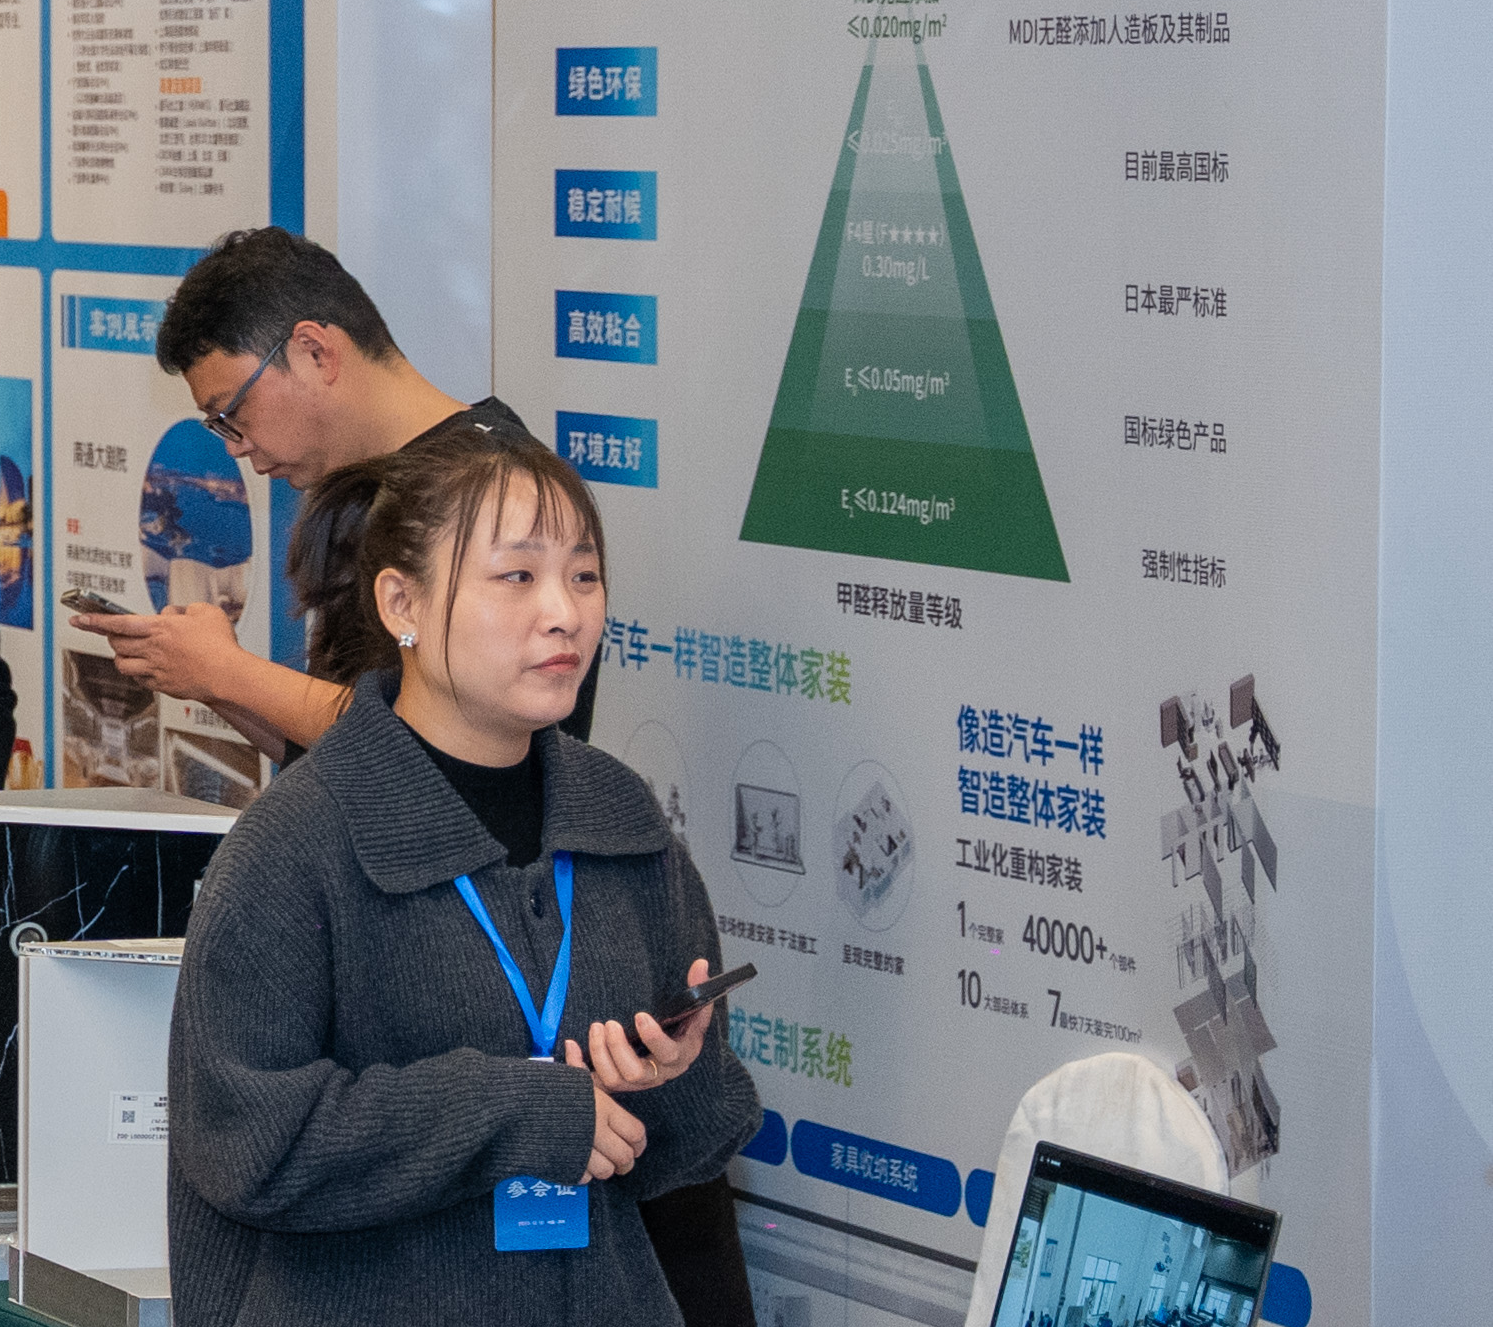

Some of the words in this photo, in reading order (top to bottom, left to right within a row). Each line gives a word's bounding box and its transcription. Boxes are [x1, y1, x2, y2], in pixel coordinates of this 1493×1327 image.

[1009, 11, 1231, 46] MDI无醛添加人造板及其制品
[567, 65, 642, 101] 绿色环保
[1124, 150, 1230, 183] 目前最高国标
[567, 187, 642, 225] 稳定耐候
[861, 254, 931, 285] 0.30mg/L
[1124, 283, 1228, 319] 日本最严标准
[567, 310, 642, 348] 高效粘合
[567, 430, 643, 472] 环境友好
[1123, 414, 1227, 455] 国标绿色产品
[1141, 548, 1227, 589] 强制性指标
[836, 581, 963, 630] 甲醛释放量等级
[957, 704, 1105, 776] 像造汽车一样
[957, 764, 1107, 840] 智造整体家装
[955, 838, 1084, 893] 工业化重构家装
[841, 943, 906, 976] 呈现完整的家
[1022, 914, 1108, 965] 40000+
[957, 969, 982, 1009] 10
[829, 1141, 919, 1195] 家具收纳系统
